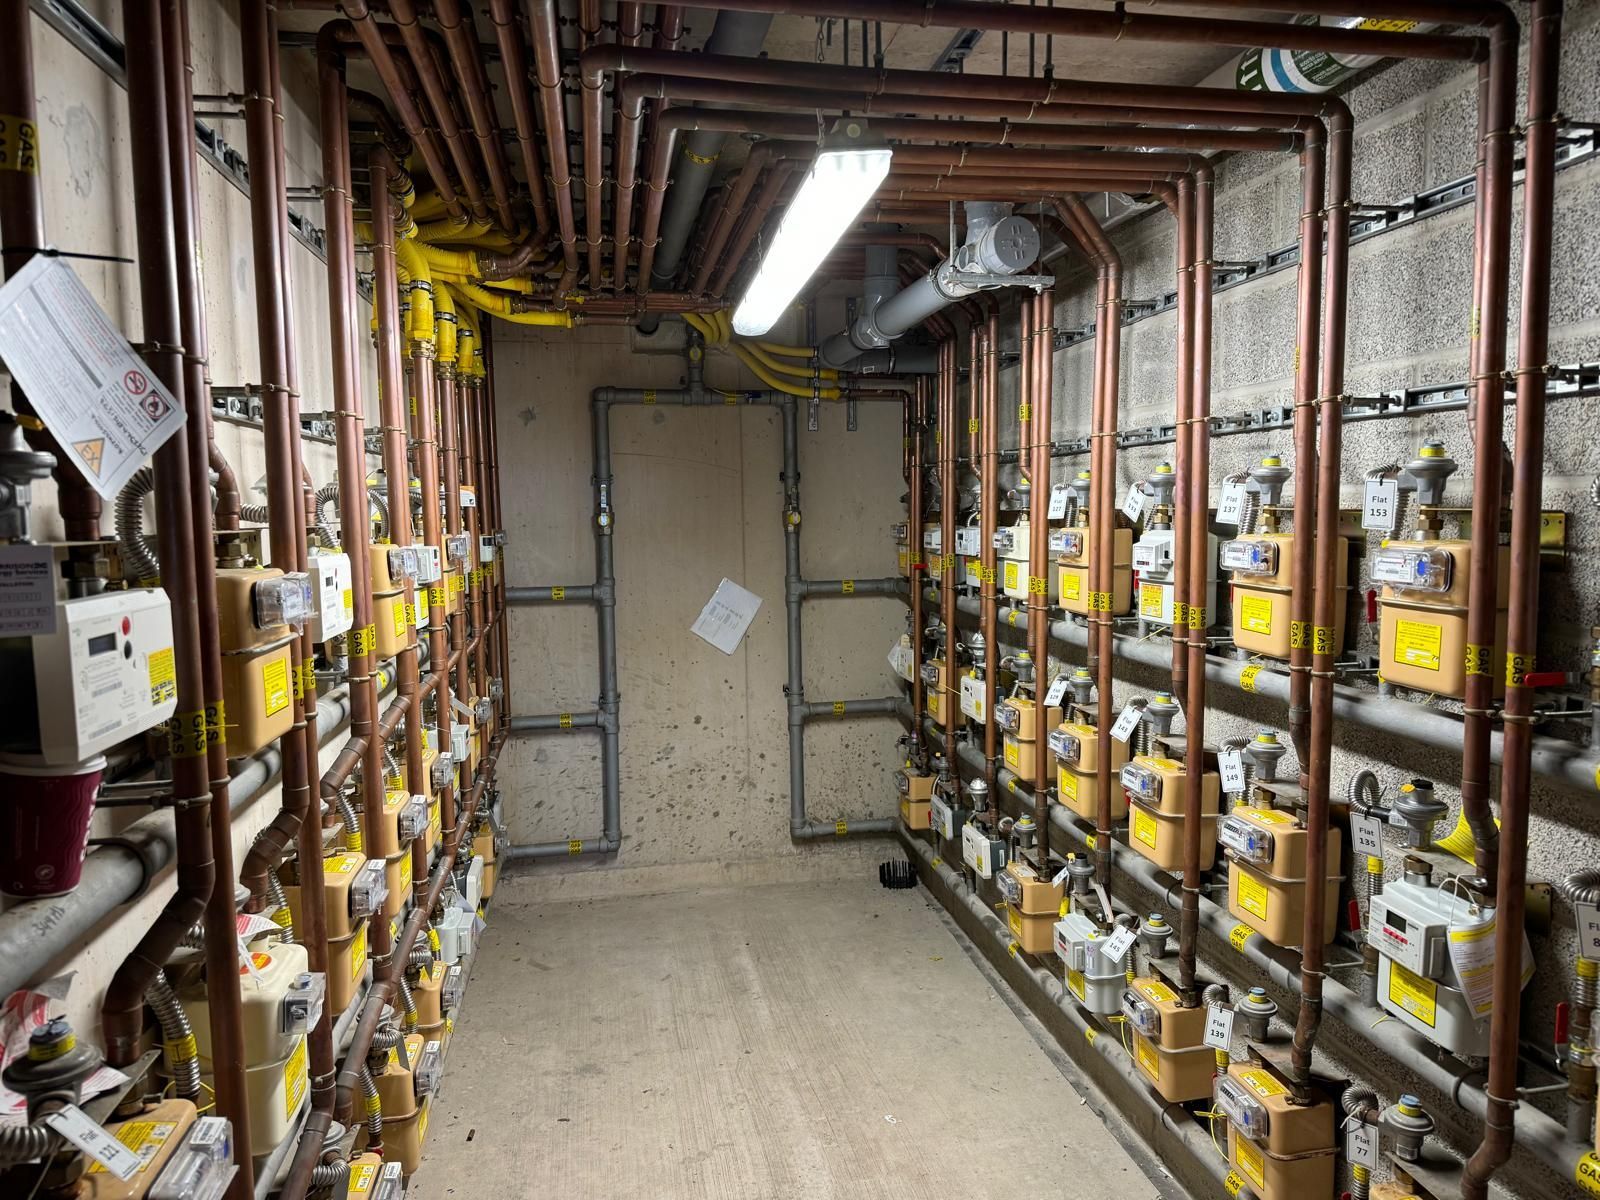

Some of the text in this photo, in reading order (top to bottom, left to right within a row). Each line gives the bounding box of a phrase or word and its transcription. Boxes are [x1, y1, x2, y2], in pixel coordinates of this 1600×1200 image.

[81, 444, 98, 466] EX
[1370, 508, 1388, 517] 153
[354, 633, 363, 654] GAS
[1317, 629, 1326, 652] GAS
[1478, 648, 1490, 674] GAS
[1241, 670, 1255, 679] GAS
[1512, 656, 1524, 685] GAS
[206, 706, 218, 741] GAS
[172, 718, 184, 754] GAS
[193, 715, 205, 751] GAS
[1359, 827, 1374, 836] Flat
[1359, 837, 1376, 848] 135
[1233, 928, 1247, 939] GAS
[1115, 936, 1125, 945] Flat
[1109, 944, 1121, 953] 145
[1213, 1019, 1225, 1028] Flat
[1210, 1029, 1224, 1039] 139
[79, 1129, 100, 1143] Flat
[1355, 1134, 1370, 1145] Flat
[99, 1144, 120, 1160] 121
[1356, 1146, 1368, 1156] 77
[1227, 1176, 1239, 1190] GAS
